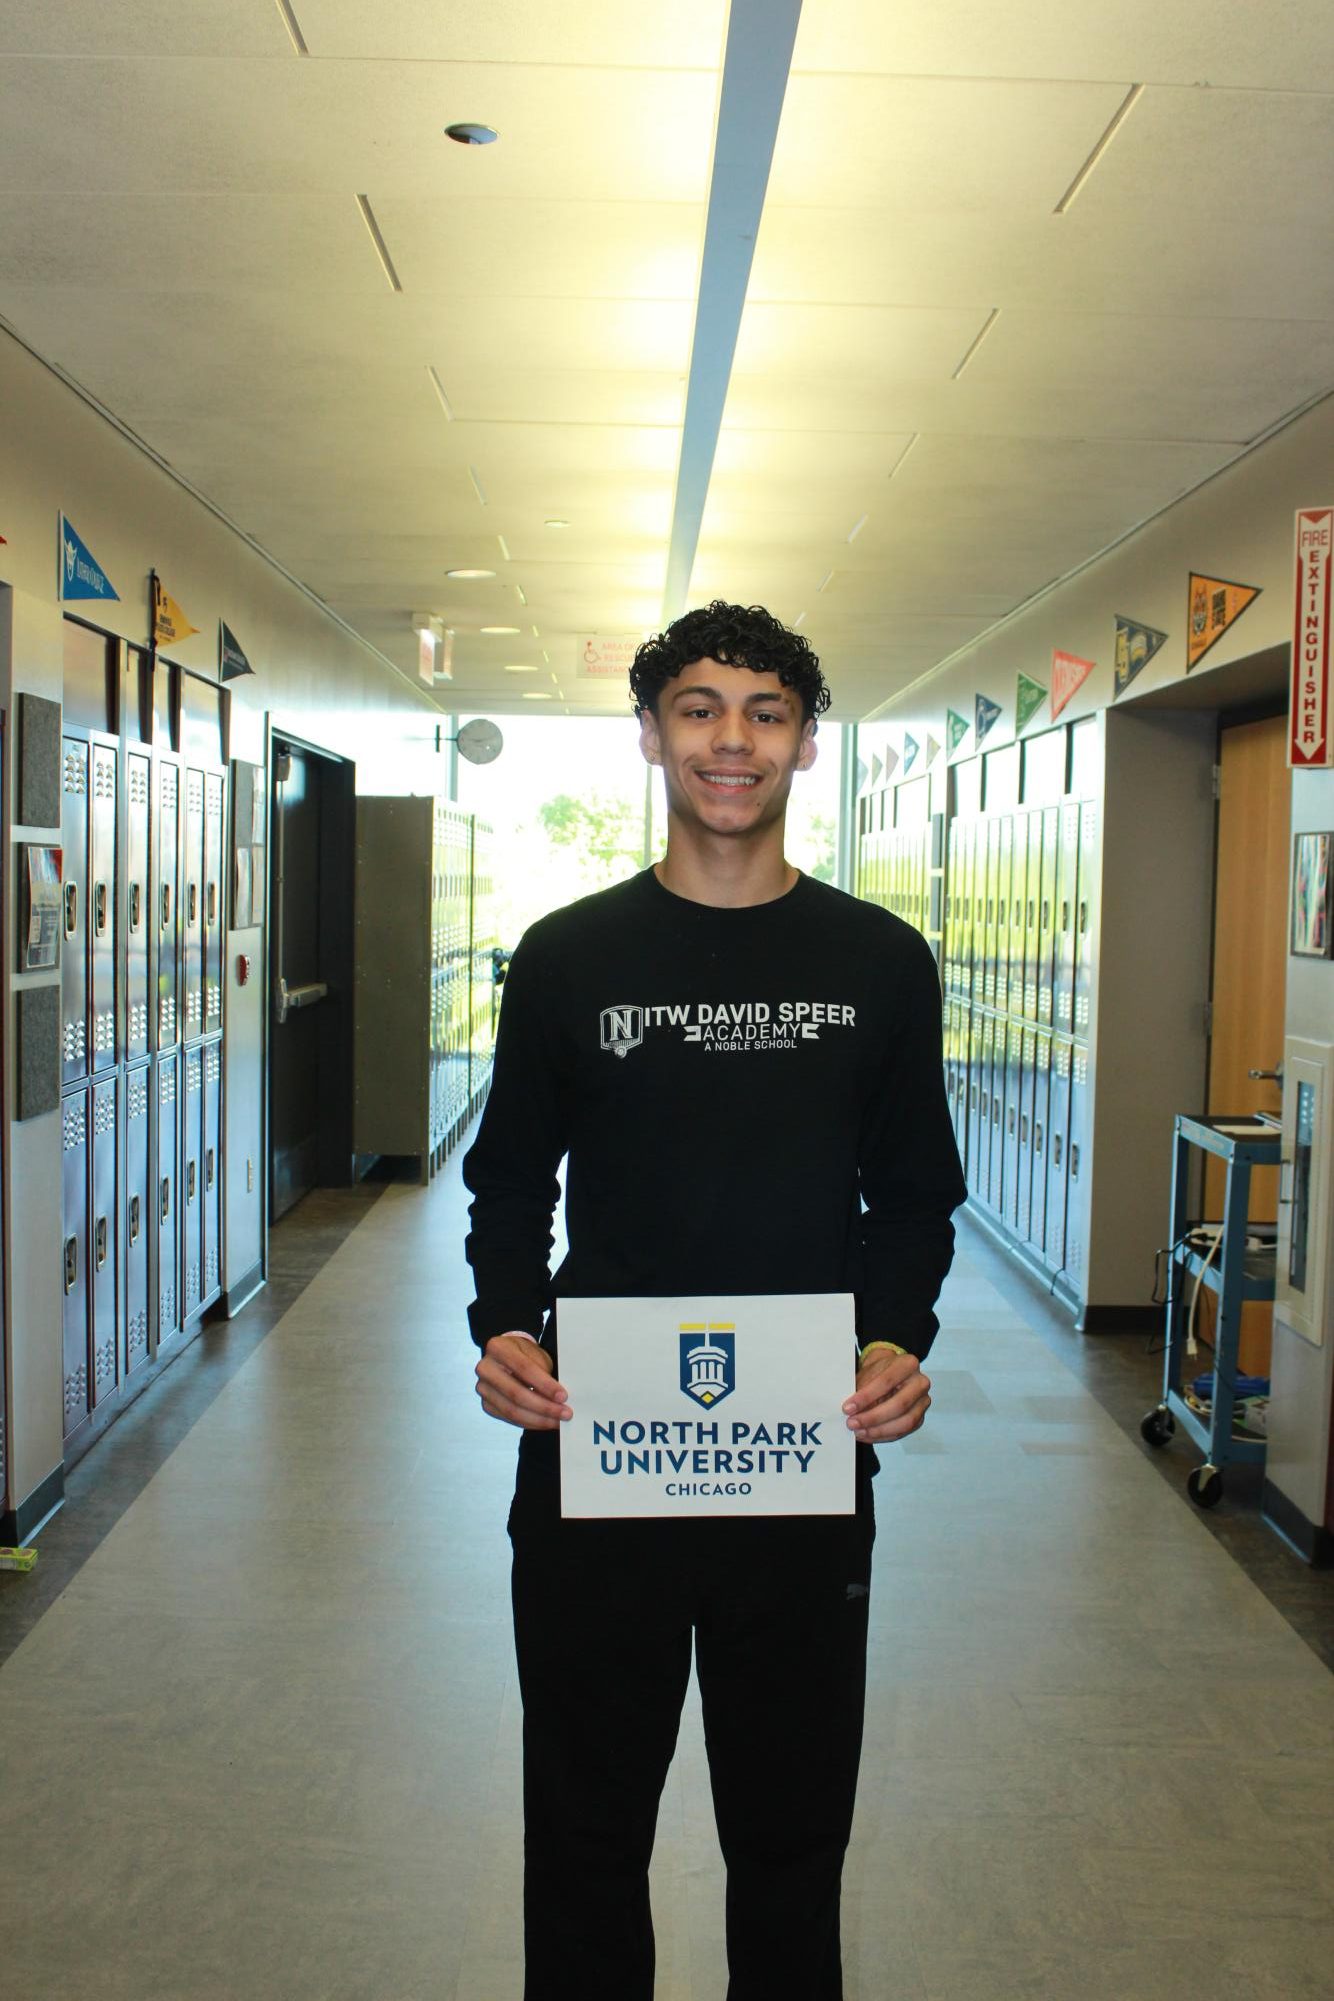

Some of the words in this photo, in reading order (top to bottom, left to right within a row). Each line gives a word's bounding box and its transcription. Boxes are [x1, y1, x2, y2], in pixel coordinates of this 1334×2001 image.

[1302, 529, 1328, 547] FIRE
[1303, 550, 1320, 744] EXTINGUISHER
[644, 1004, 691, 1028] ITW
[697, 1002, 771, 1025] DAVID
[778, 1001, 856, 1027] SPEER
[702, 1023, 801, 1041] ACADEMY
[704, 1041, 712, 1052] A
[714, 1041, 751, 1052] NOBLE
[754, 1039, 798, 1050] SCHOOL
[593, 1420, 719, 1445] NORTH
[731, 1421, 823, 1446] PARK
[600, 1449, 816, 1475] UNIVERSITY
[665, 1482, 752, 1497] CHICAGO
